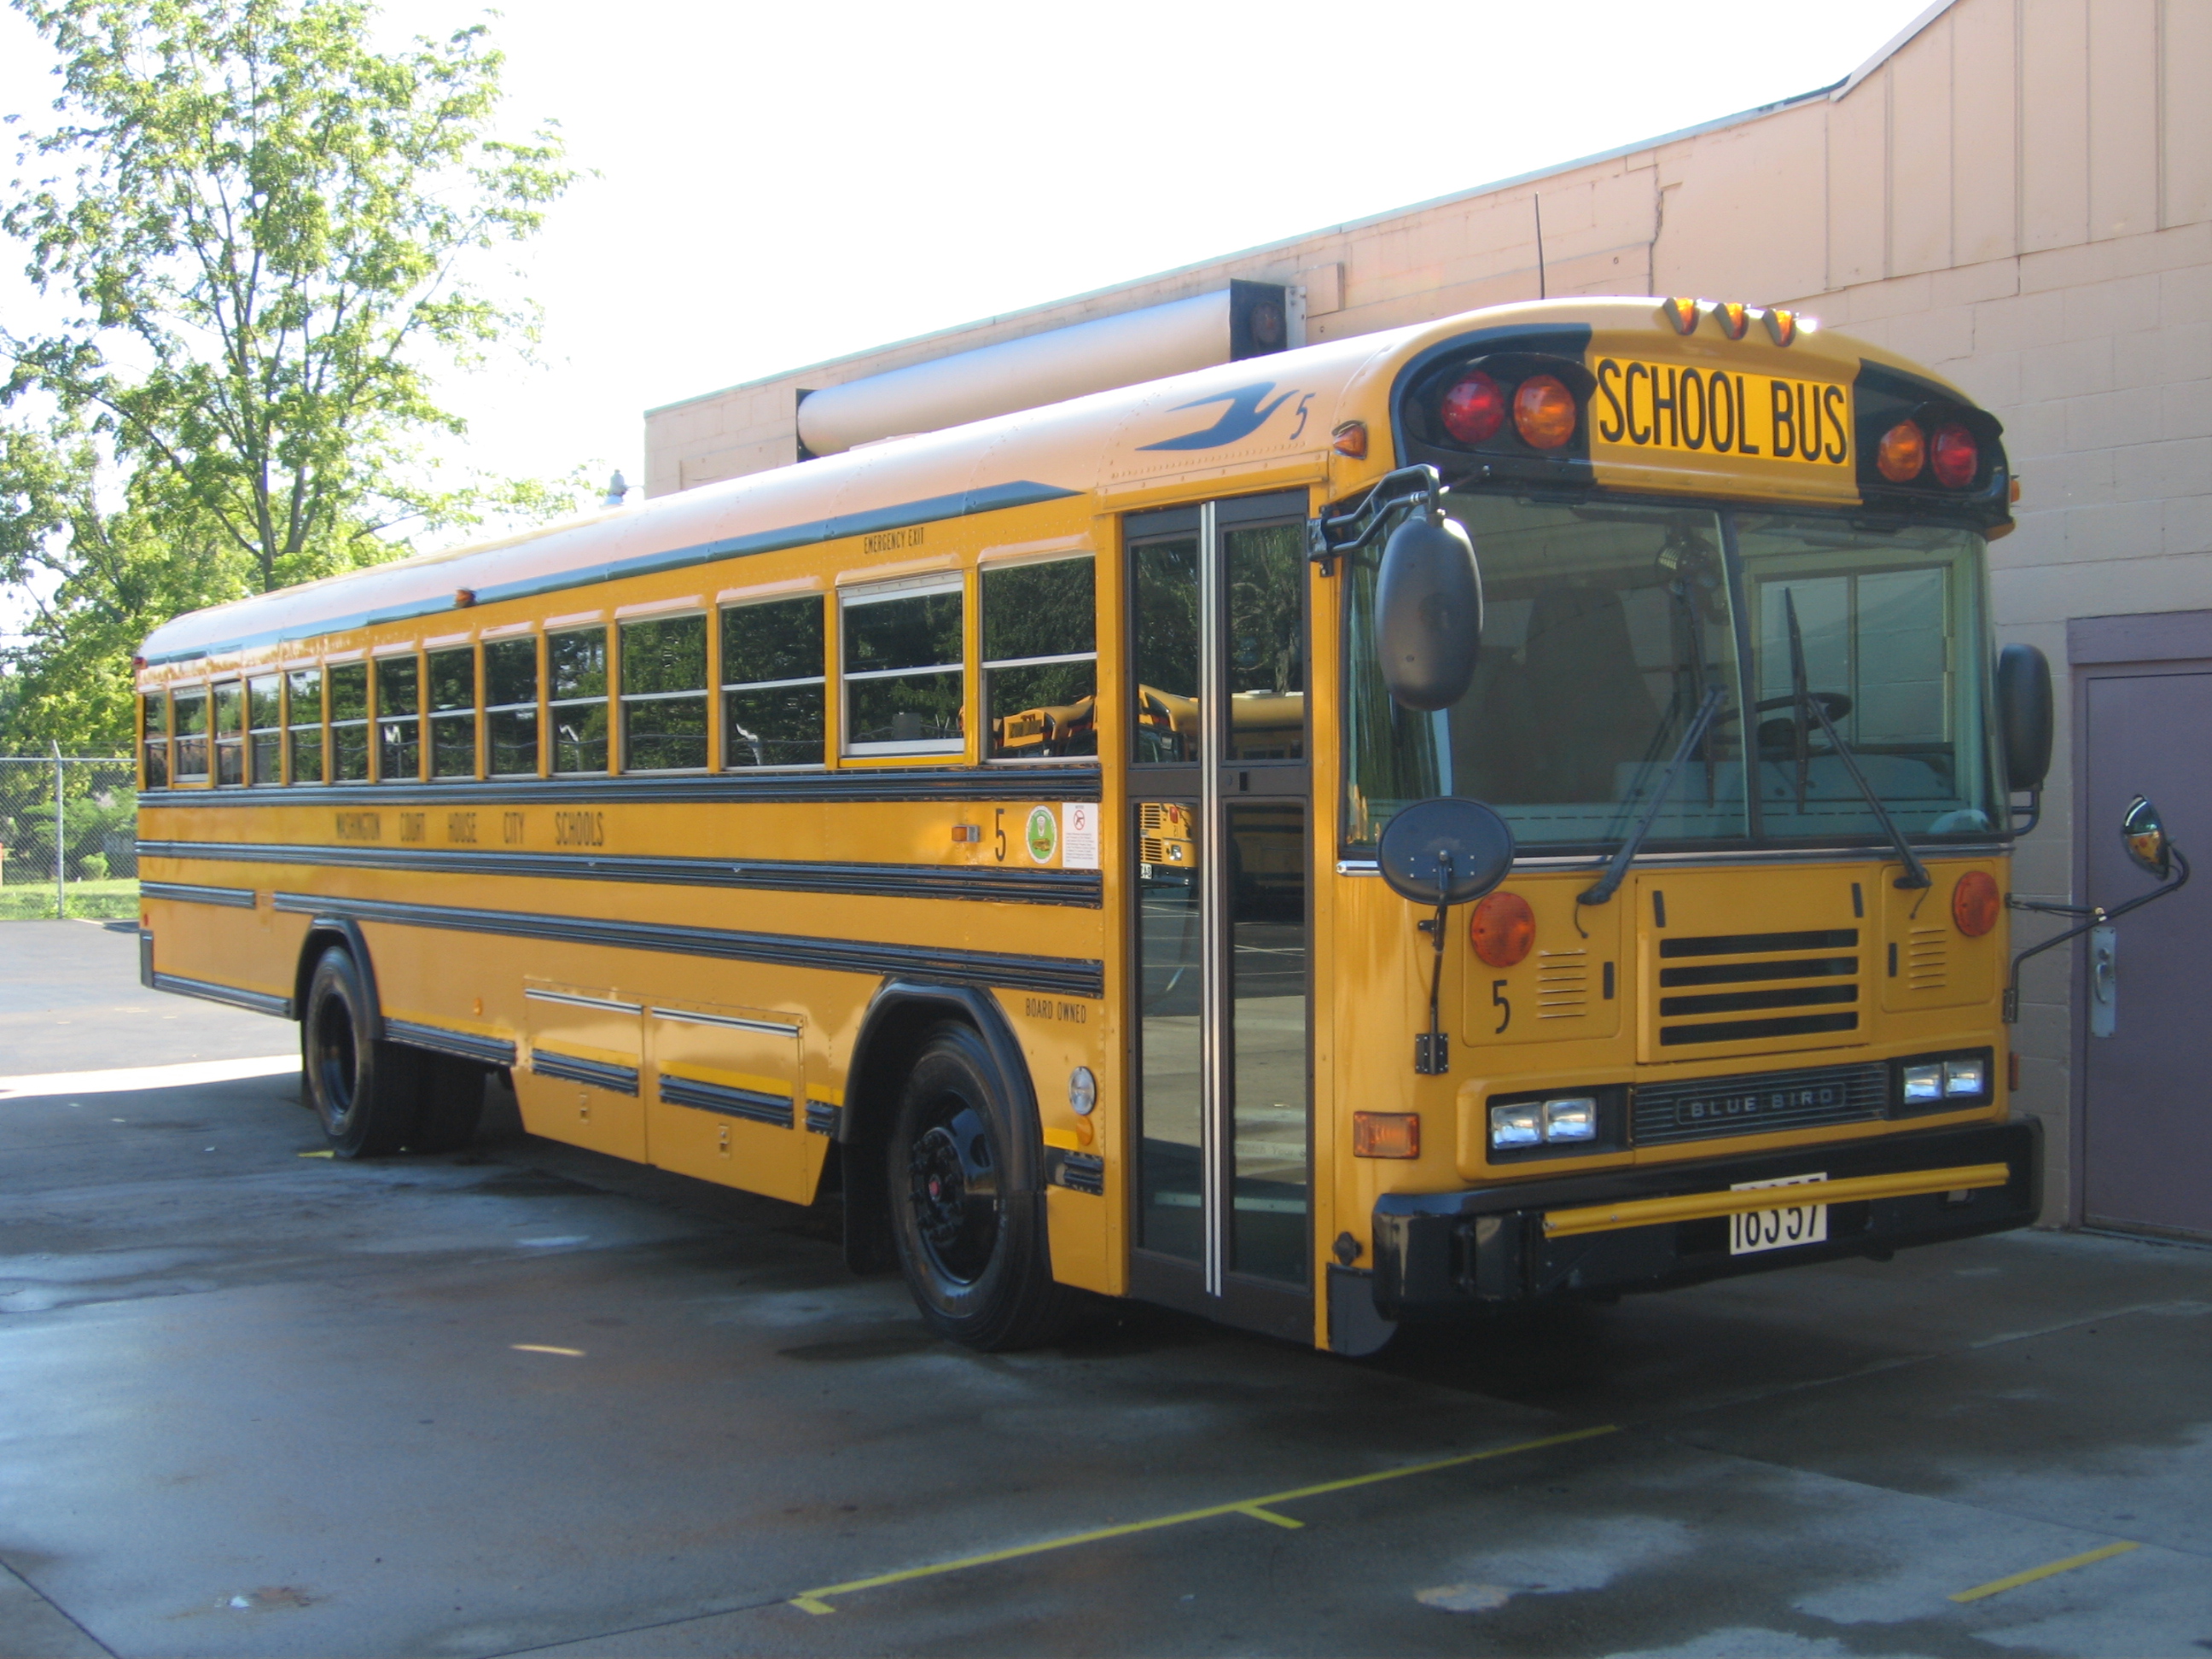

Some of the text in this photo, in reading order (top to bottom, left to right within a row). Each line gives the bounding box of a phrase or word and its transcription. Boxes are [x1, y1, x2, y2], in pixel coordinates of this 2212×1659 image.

[1289, 392, 1316, 440] 5
[1597, 358, 1847, 464] SCHOOL BUS
[864, 527, 924, 554] EMERGENCY EXIT
[504, 812, 525, 843] CITY
[556, 812, 604, 846] SCHOOLS
[995, 808, 1007, 862] 5
[1026, 998, 1086, 1023] BOARD OWNED
[1493, 979, 1511, 1034] 5
[1691, 1088, 1833, 1118] BLUE BIRD
